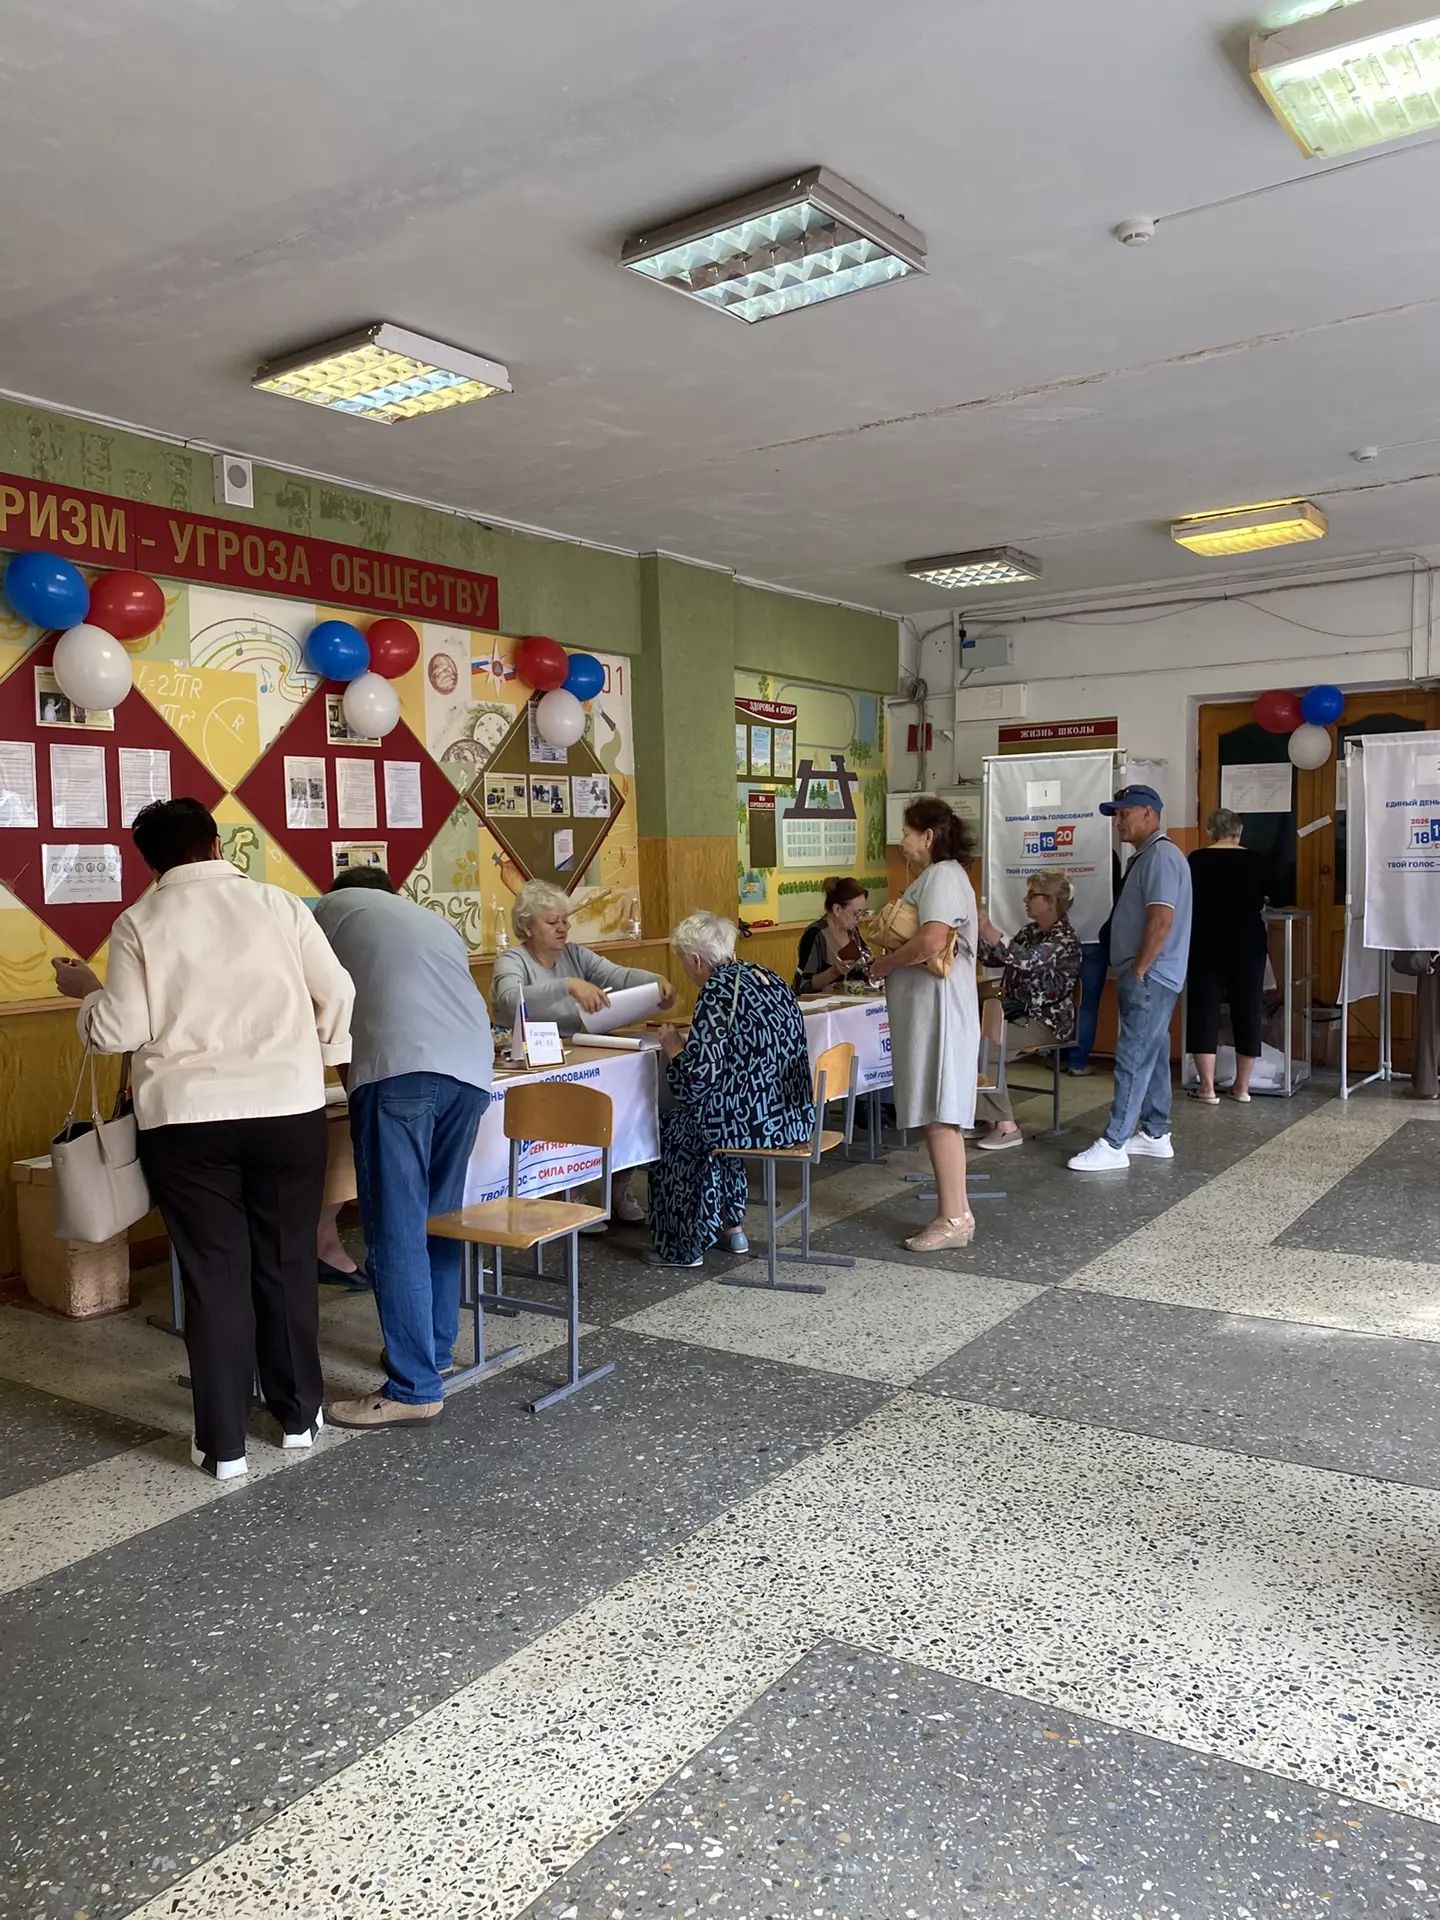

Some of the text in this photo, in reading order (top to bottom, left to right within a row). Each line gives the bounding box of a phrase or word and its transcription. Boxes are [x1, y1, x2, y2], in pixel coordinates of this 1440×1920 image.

[0, 485, 126, 553] РИЗМ
[168, 520, 311, 586] УГРОЗА
[330, 553, 489, 617] ОБЩЕСТВУ
[749, 701, 775, 713] ЗДОРОВЬЕ
[231, 714, 245, 731] R
[1020, 726, 1095, 739] ЖИЗНЬ ШКОЛЫ
[1386, 799, 1417, 808] ЕДИНЫЙ
[1005, 814, 1030, 822] ЕДИНЫЙ
[1048, 812, 1094, 821] ГОЛОСОВАНИЯ
[1025, 831, 1072, 854] 18 19 20
[1413, 831, 1430, 844] 18
[881, 1038, 891, 1053] 18
[480, 1186, 505, 1202] ТВОЙ
[538, 1166, 565, 1180] СИЛА
